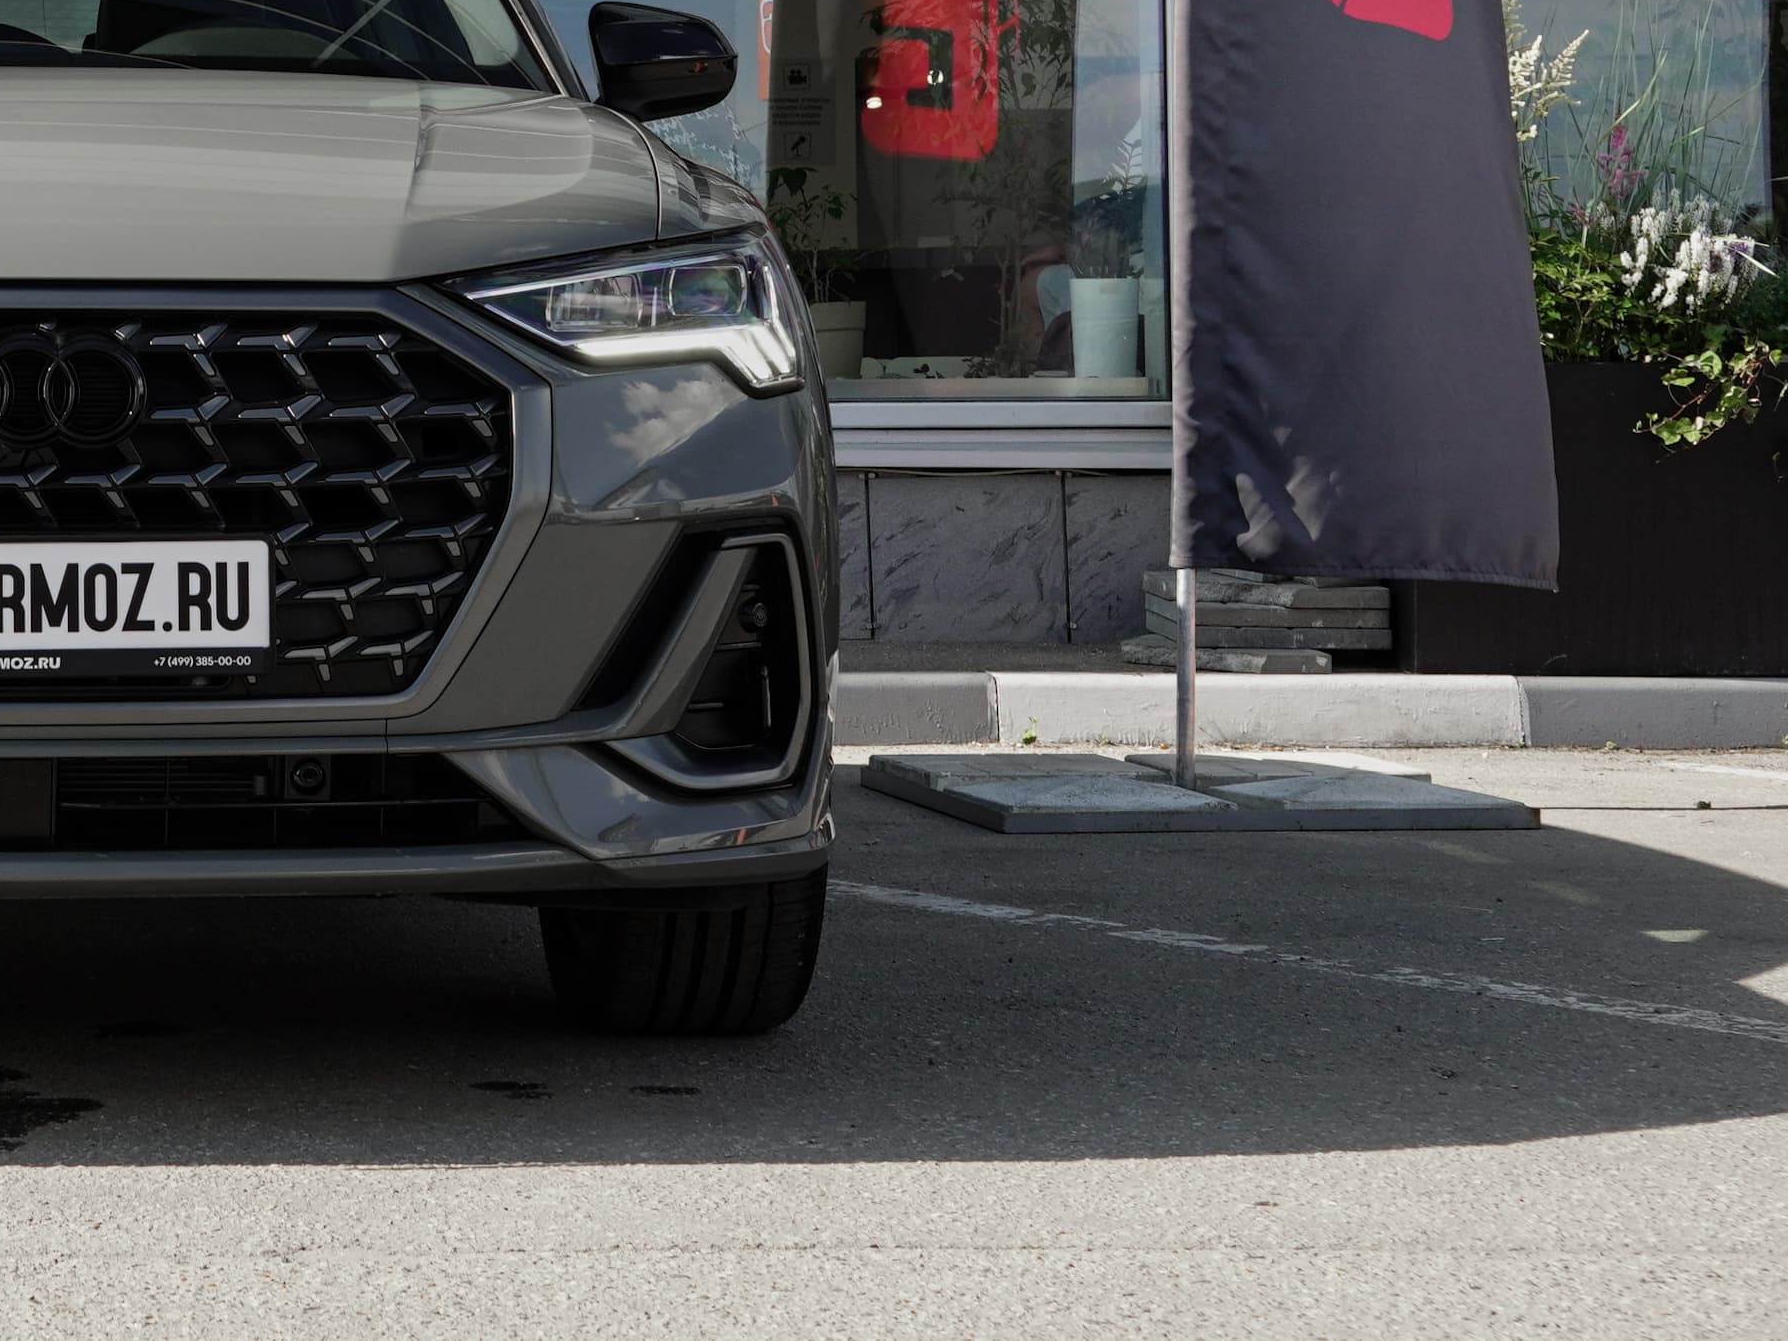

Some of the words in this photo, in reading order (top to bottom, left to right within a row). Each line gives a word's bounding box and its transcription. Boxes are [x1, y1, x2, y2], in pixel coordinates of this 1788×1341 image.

[154, 656, 166, 667] +7
[167, 655, 194, 668] (499)
[195, 655, 252, 667] 385-00-00
